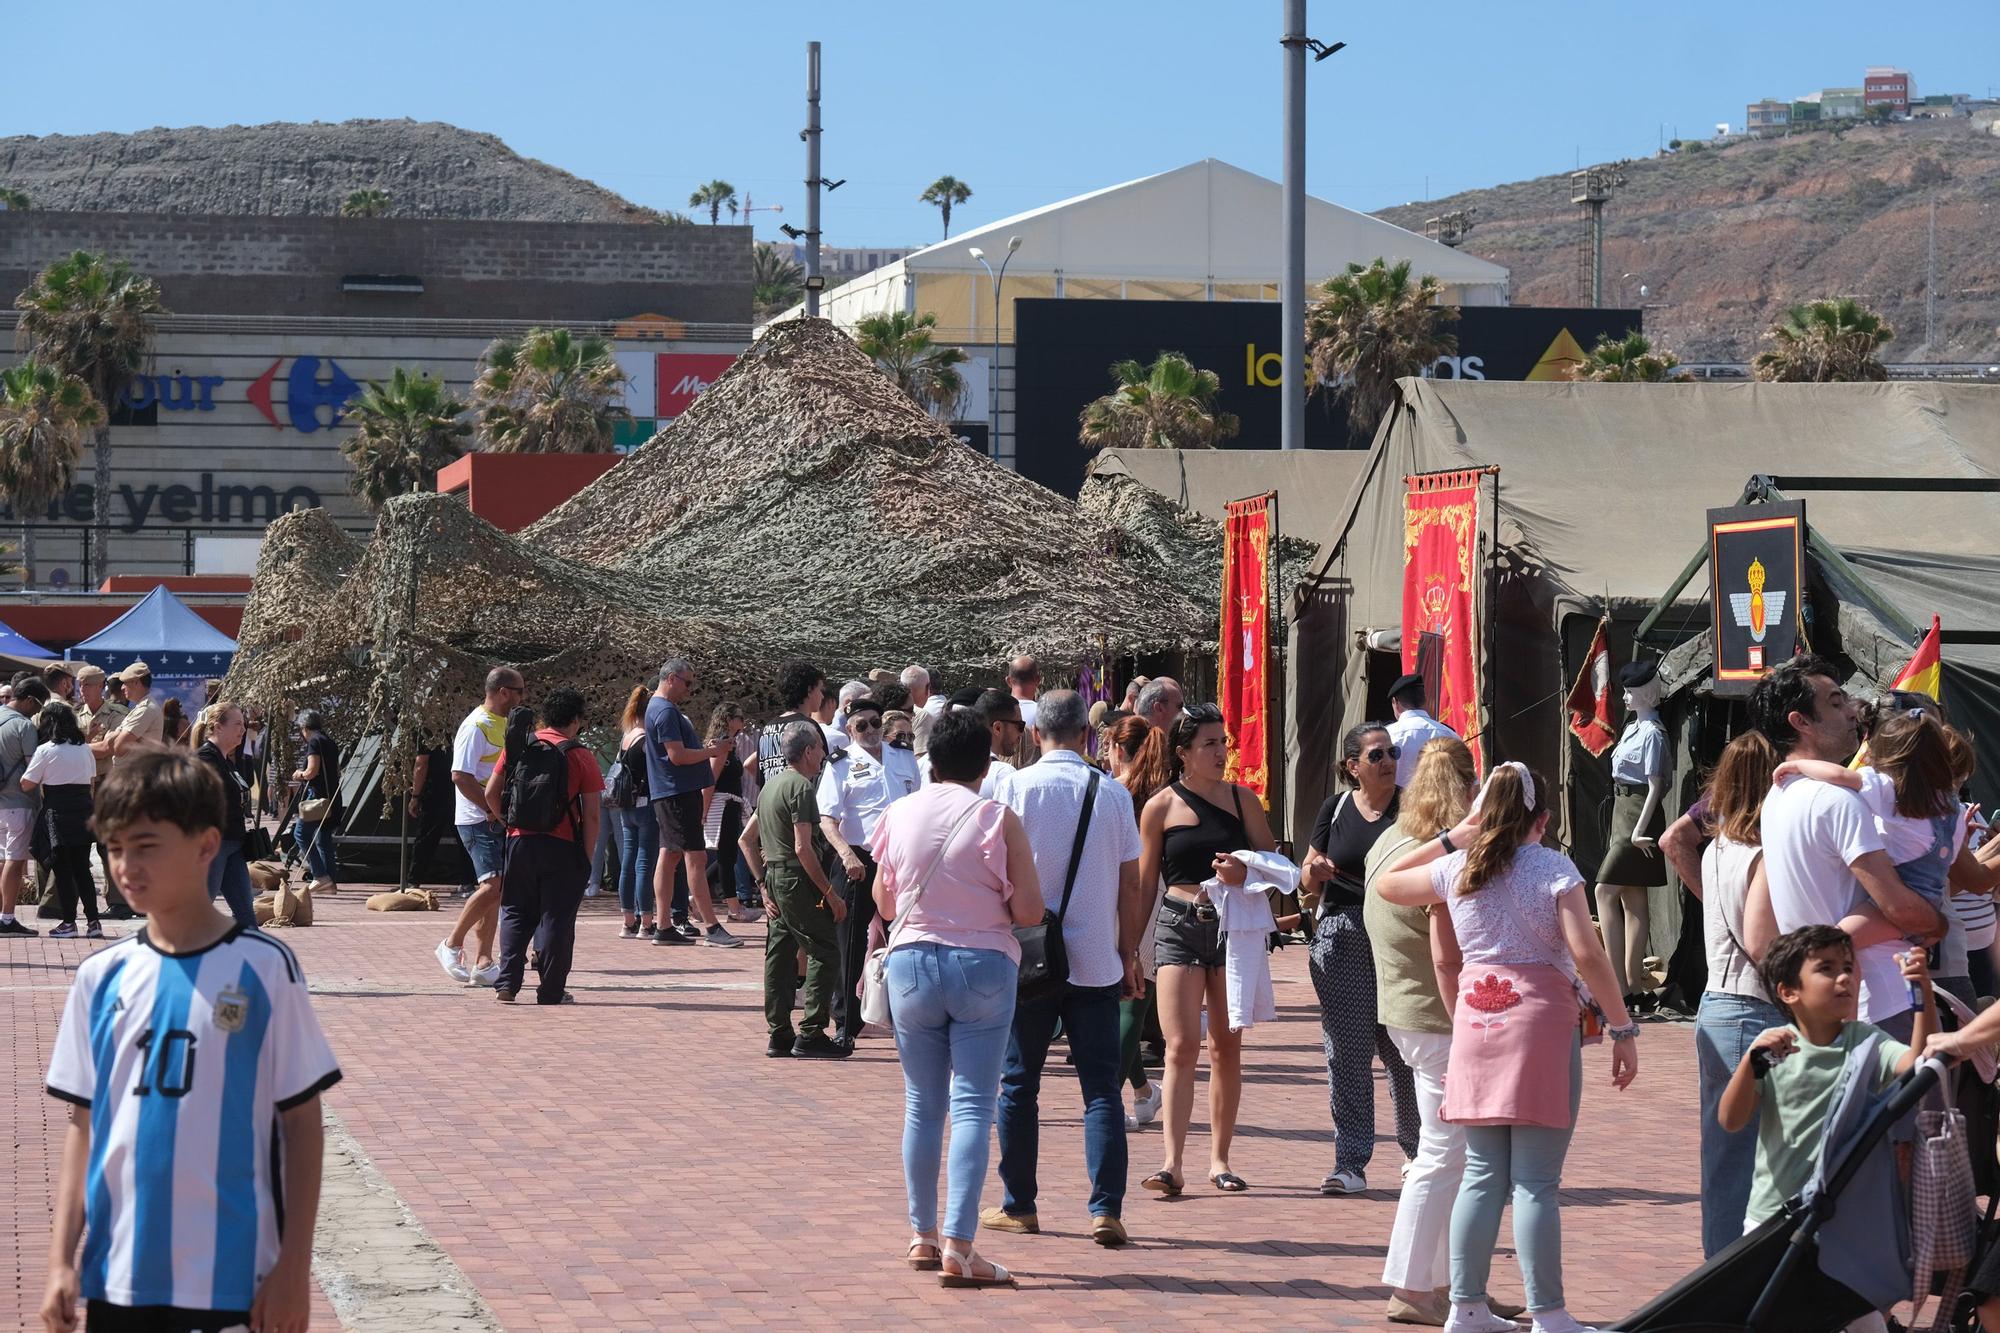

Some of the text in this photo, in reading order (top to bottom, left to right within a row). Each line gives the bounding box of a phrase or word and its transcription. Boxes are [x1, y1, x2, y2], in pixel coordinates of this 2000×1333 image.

[119, 472, 321, 534] yelmo
[763, 723, 784, 735] ONLY
[133, 1029, 197, 1098] 10
